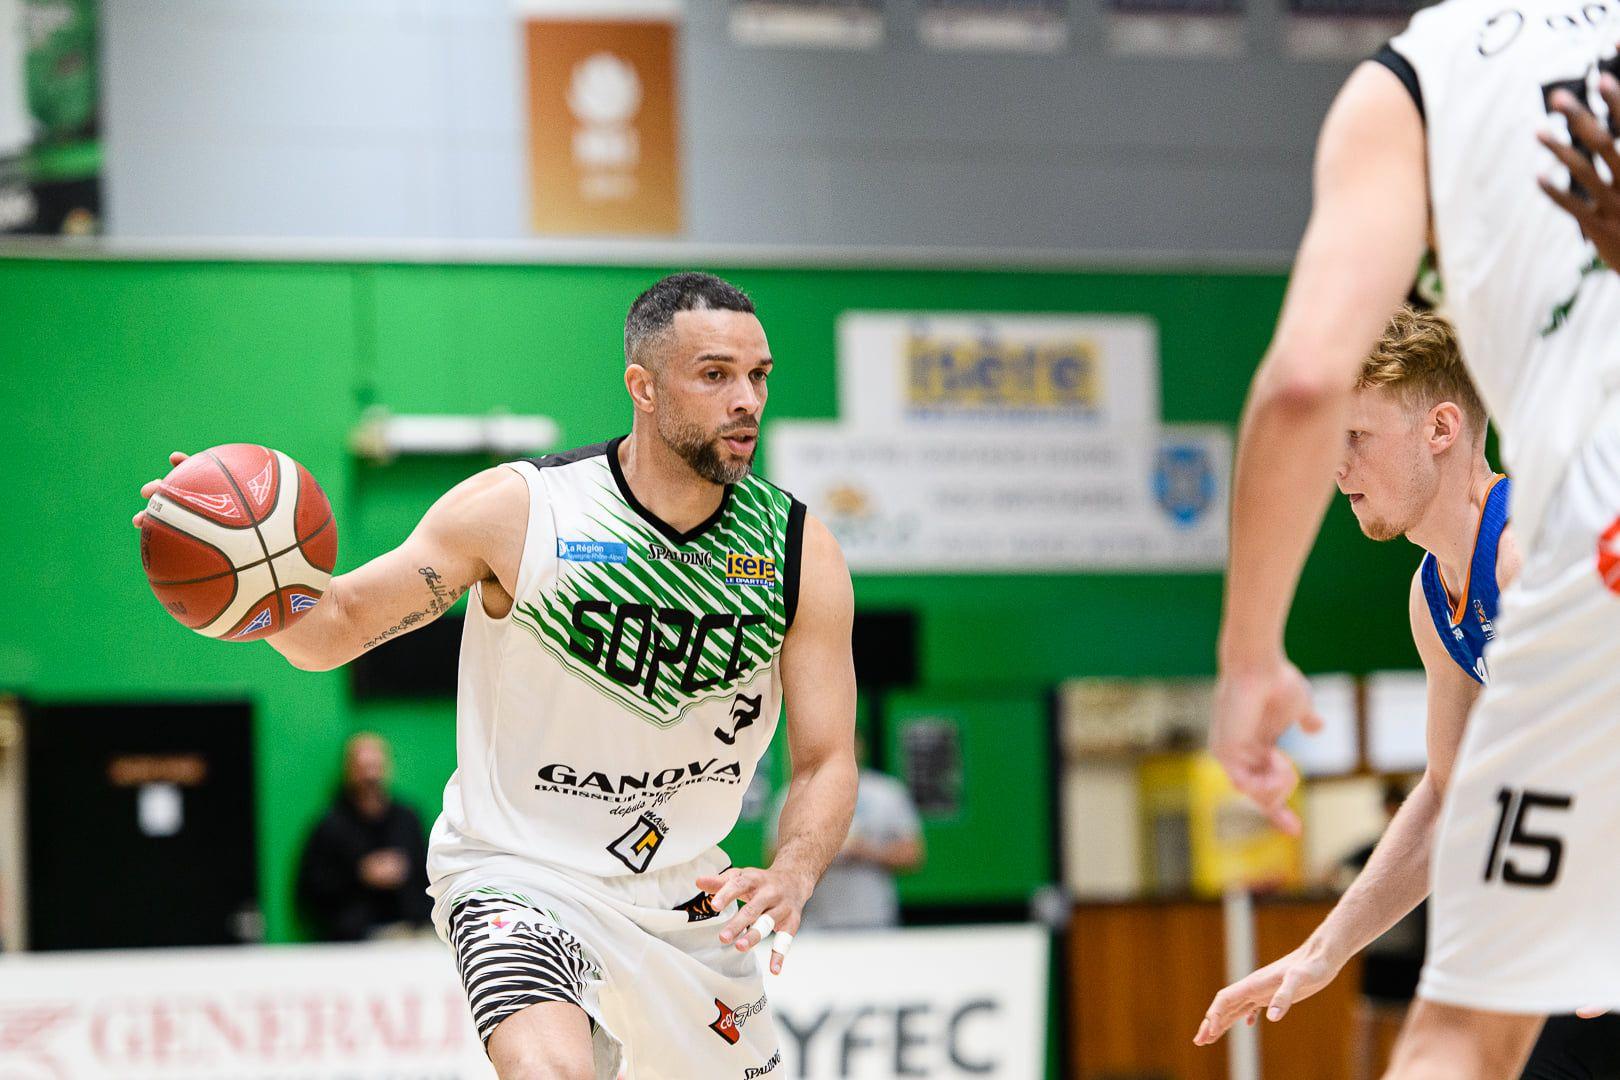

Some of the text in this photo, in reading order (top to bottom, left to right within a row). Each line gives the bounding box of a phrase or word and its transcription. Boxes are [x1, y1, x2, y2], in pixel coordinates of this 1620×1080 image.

[576, 543, 604, 554] Région
[647, 543, 712, 568] SPALDING
[537, 759, 741, 795] GANOVA
[1484, 787, 1573, 886] 15
